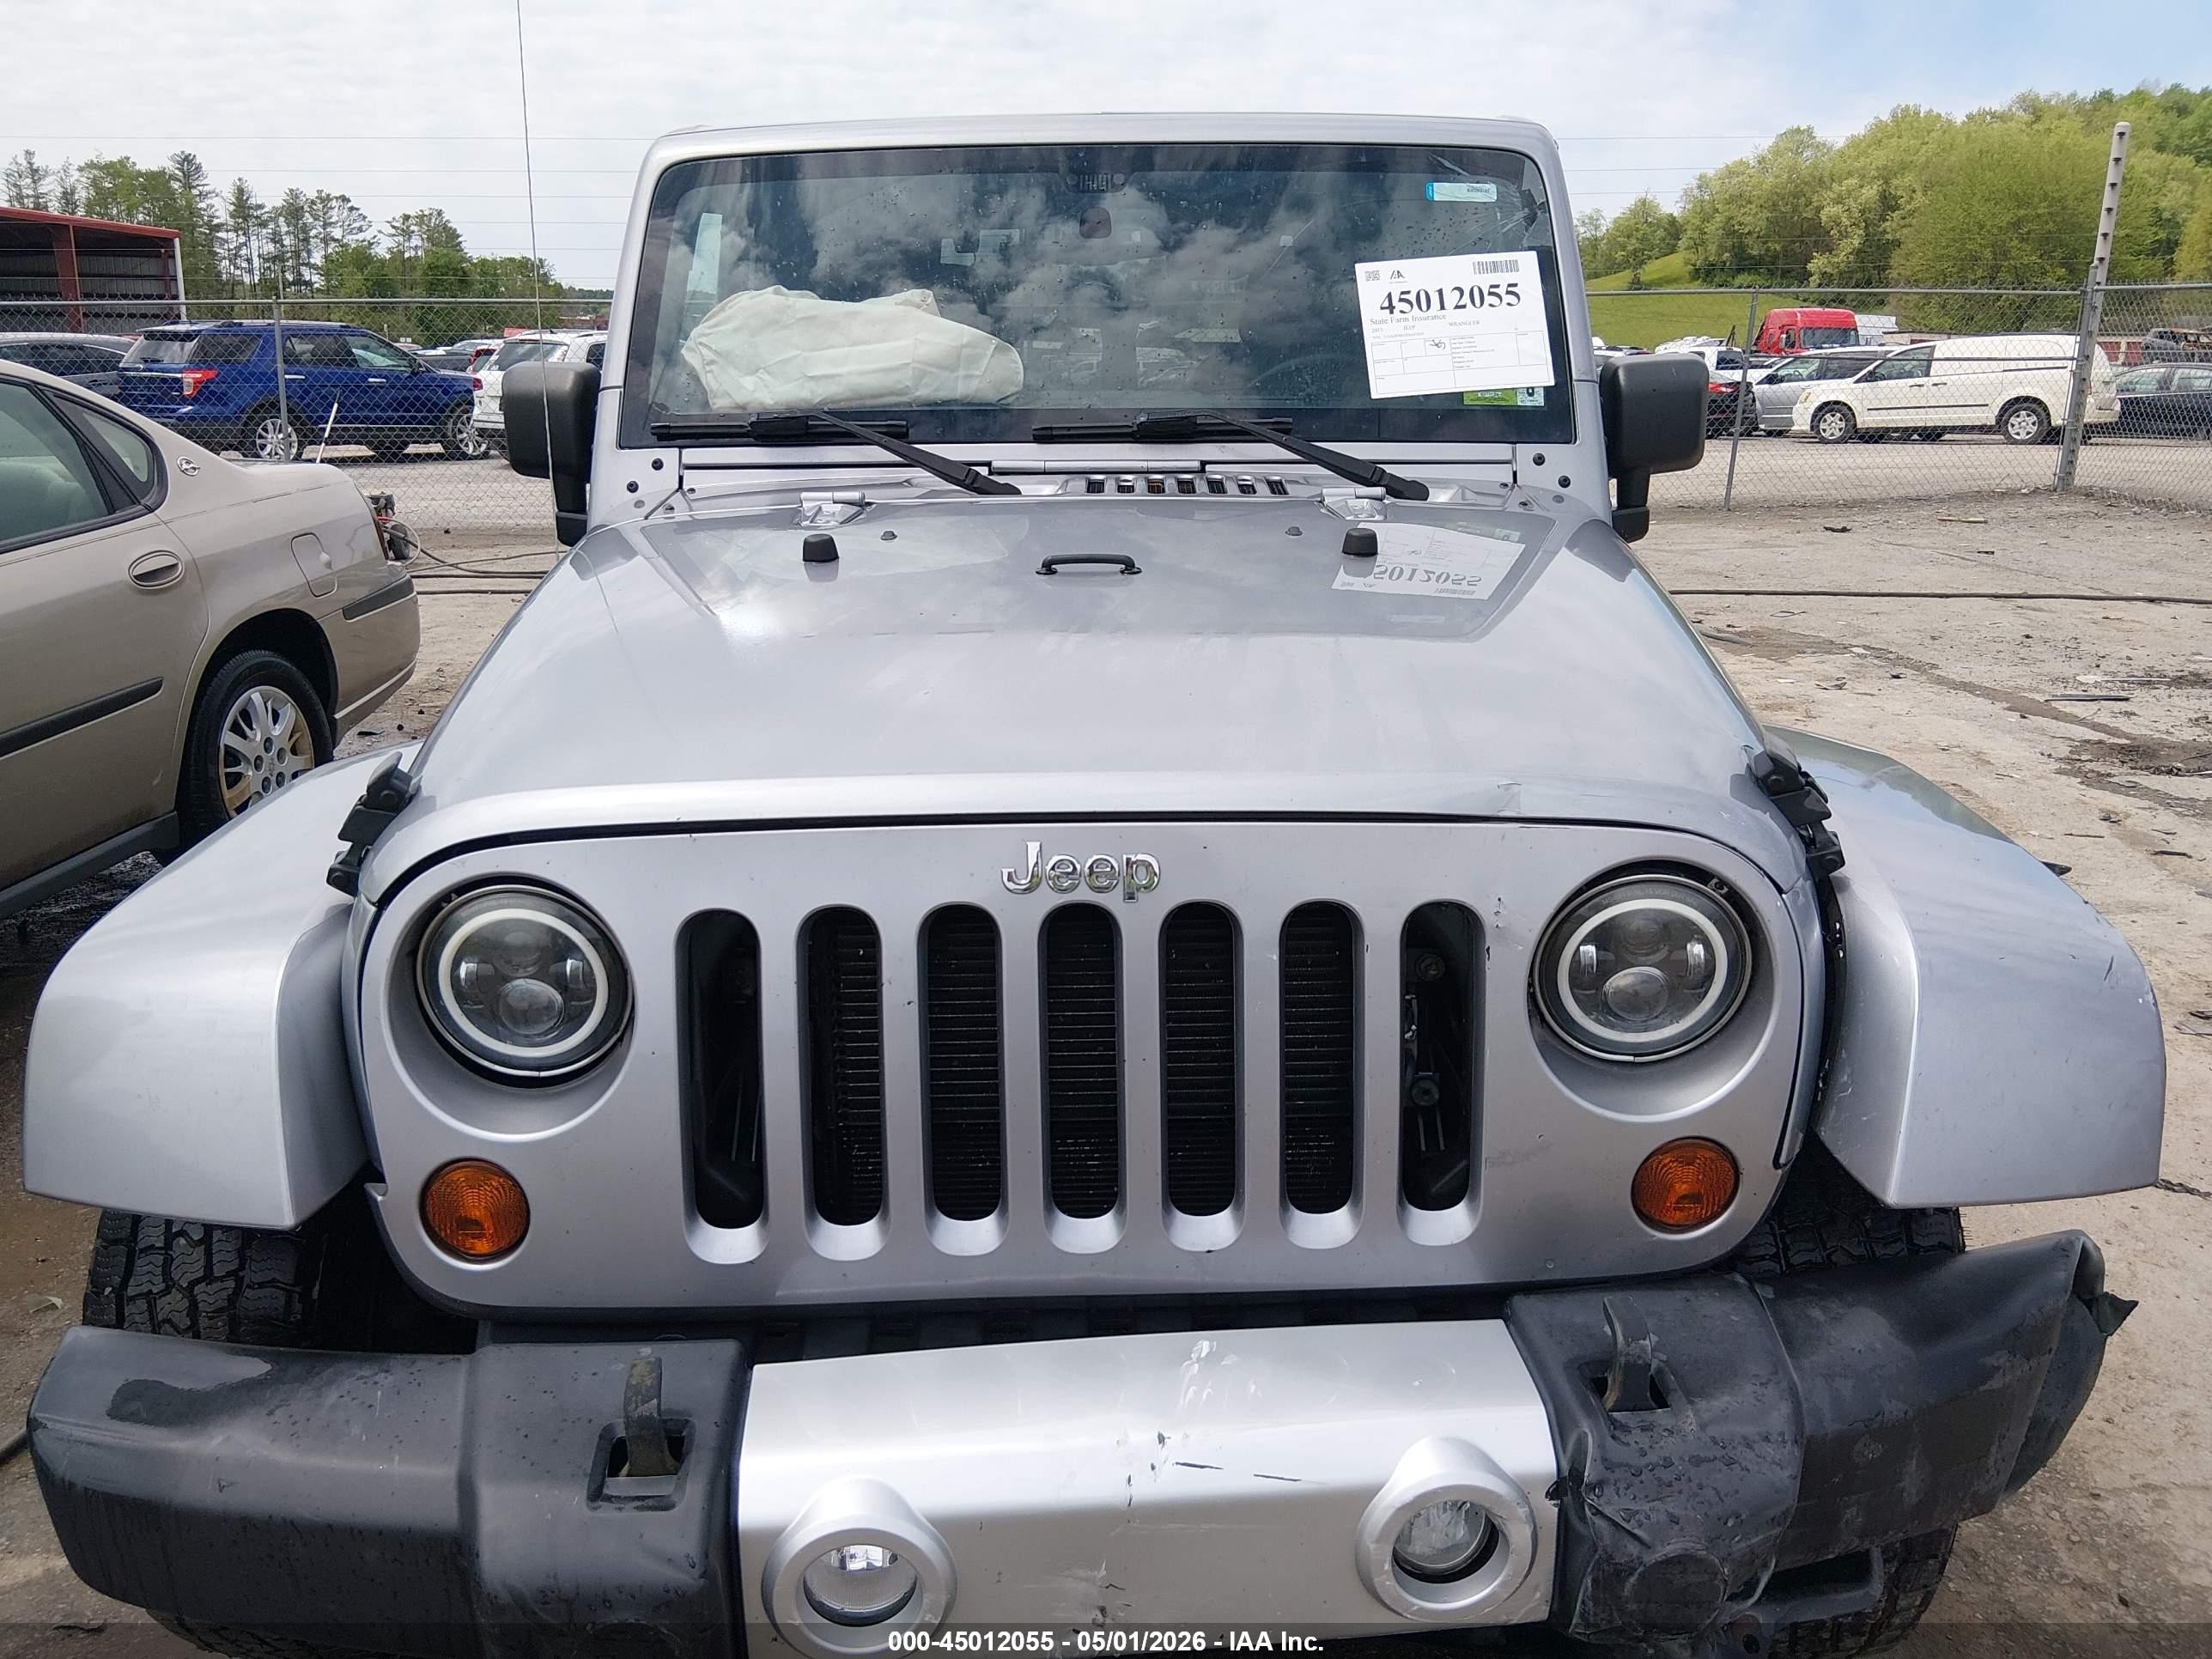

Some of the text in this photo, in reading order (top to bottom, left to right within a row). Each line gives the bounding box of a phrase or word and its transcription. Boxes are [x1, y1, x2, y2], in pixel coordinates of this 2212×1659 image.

[1379, 283, 1522, 315] 45012055
[1412, 314, 1447, 323] Insurance
[1000, 841, 1161, 903] Jeep
